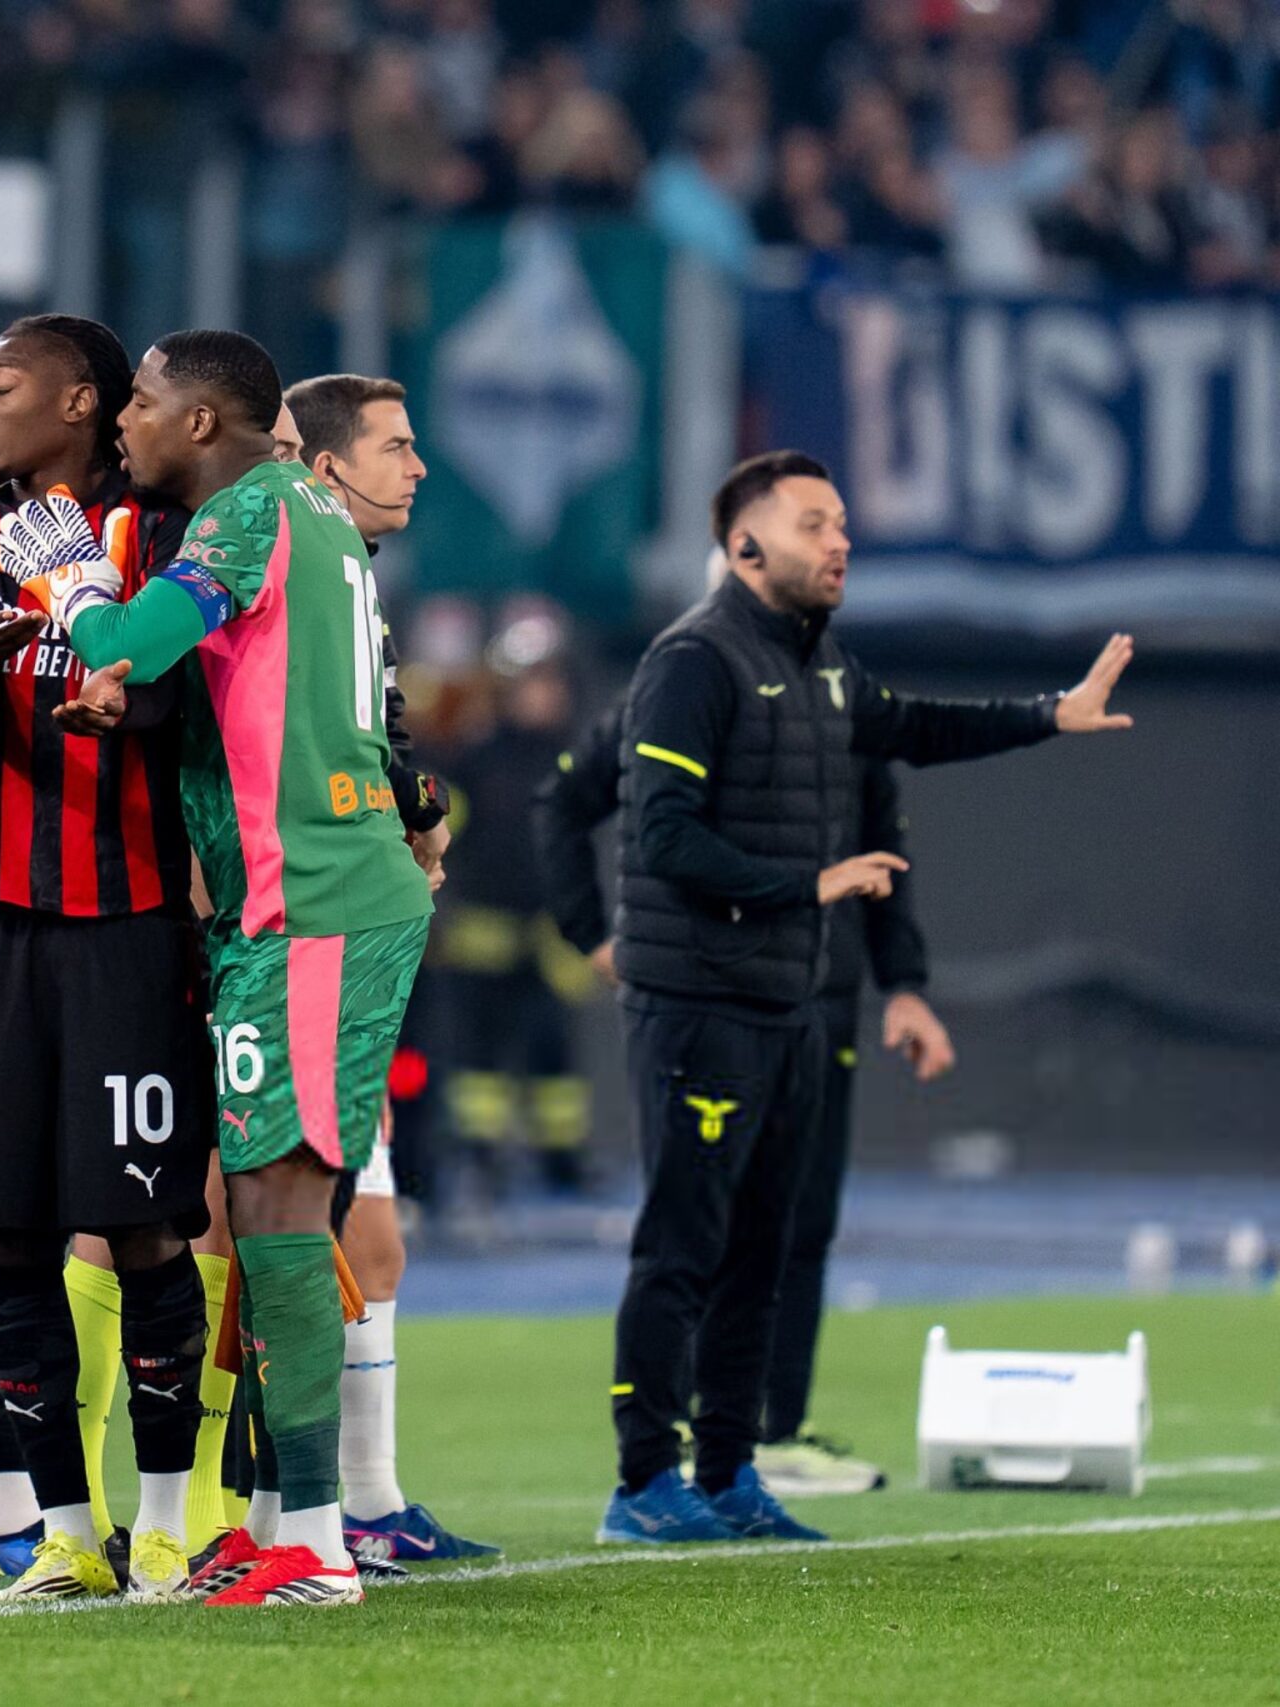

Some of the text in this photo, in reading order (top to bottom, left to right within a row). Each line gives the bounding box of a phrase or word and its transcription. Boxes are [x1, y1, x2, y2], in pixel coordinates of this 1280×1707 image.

[342, 554, 387, 732] 16
[212, 1022, 265, 1095] 16
[104, 1073, 173, 1146] 10
